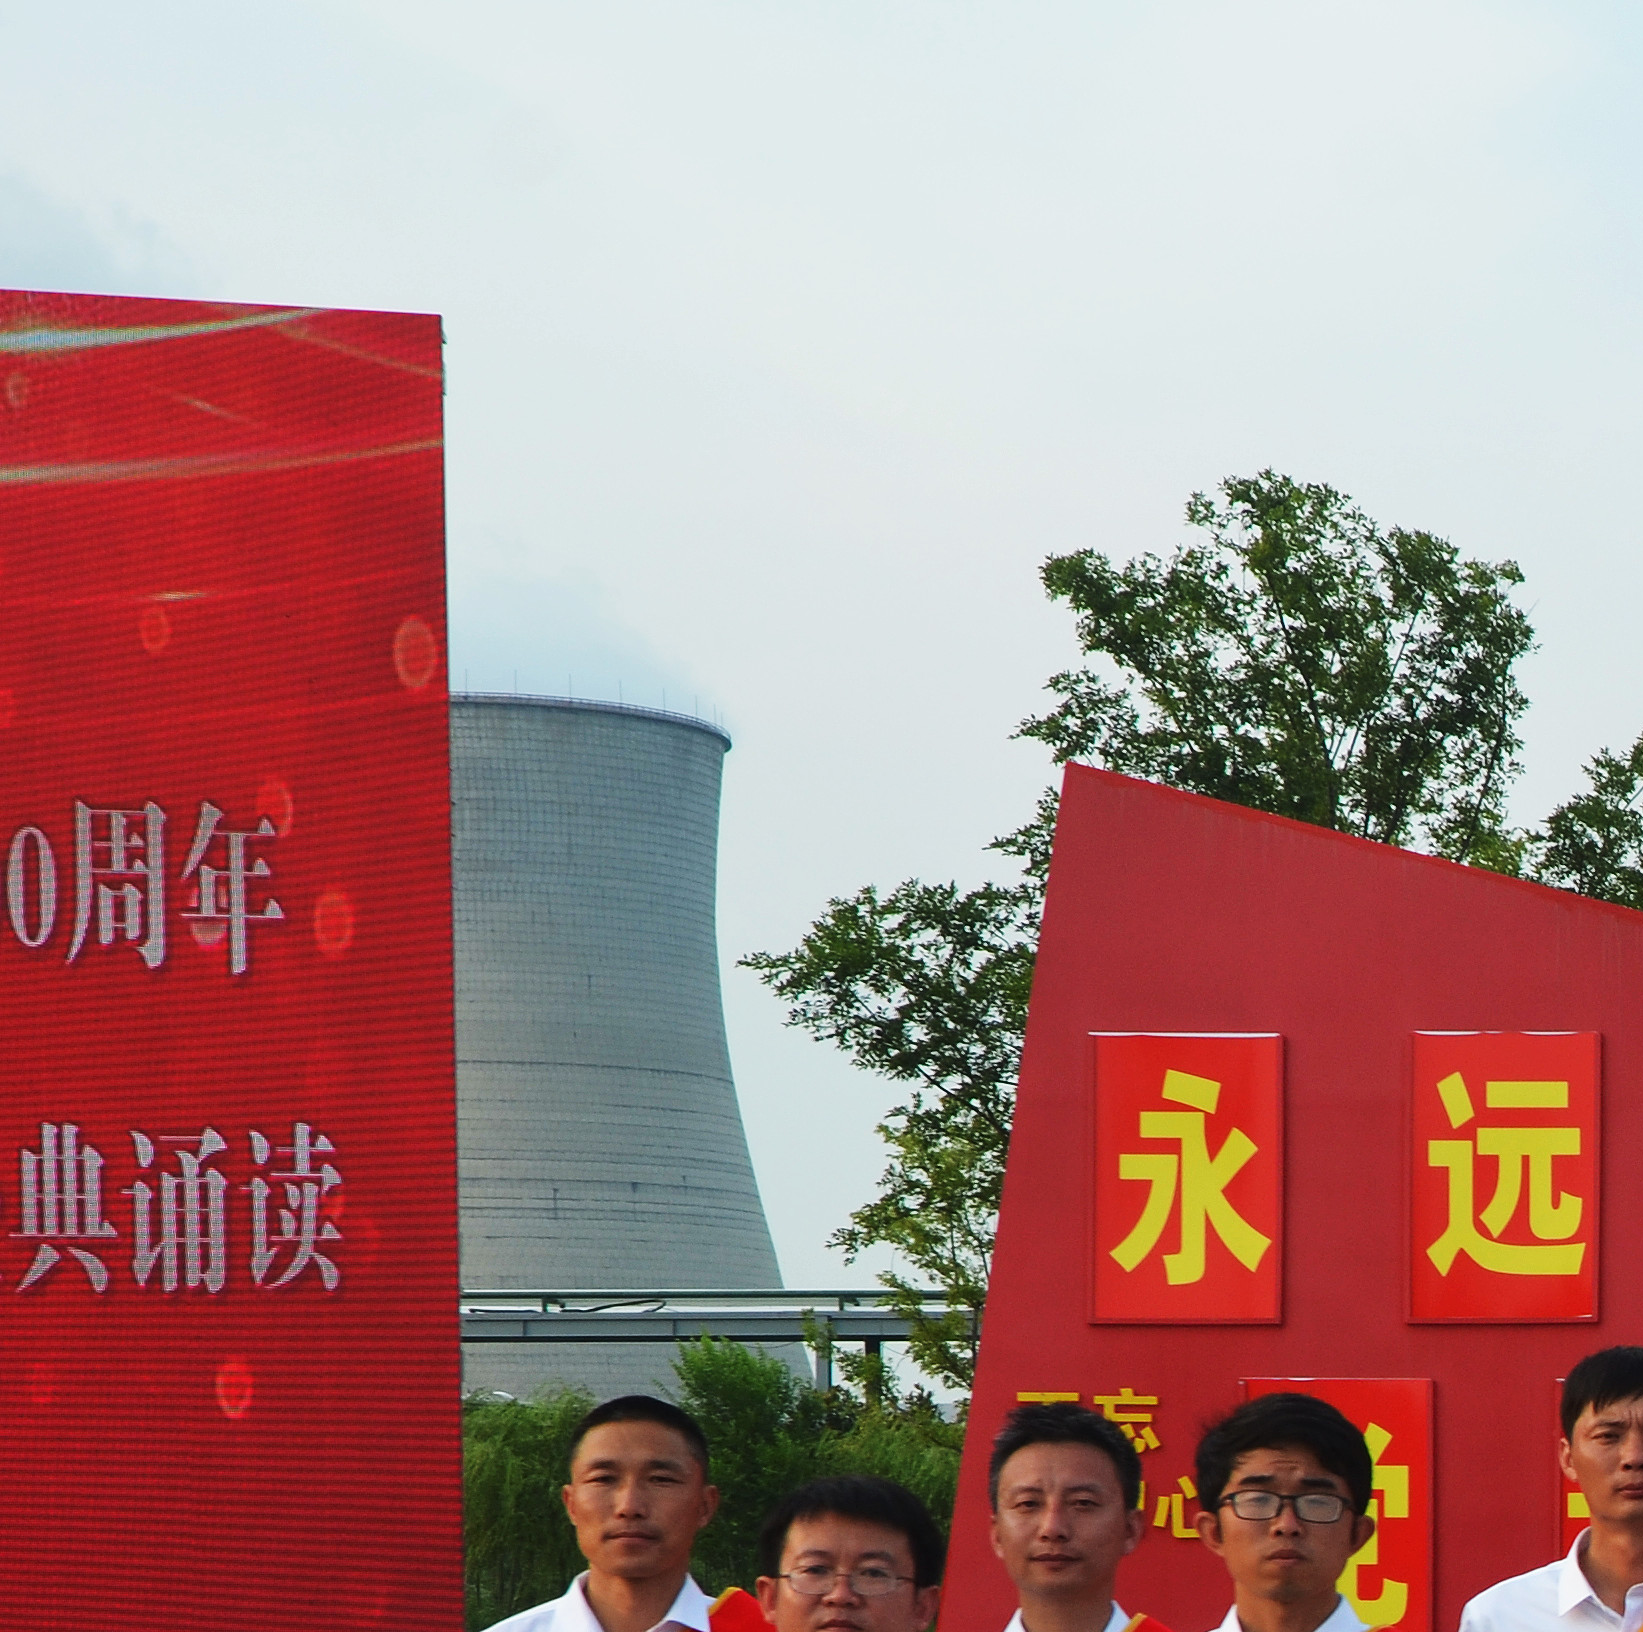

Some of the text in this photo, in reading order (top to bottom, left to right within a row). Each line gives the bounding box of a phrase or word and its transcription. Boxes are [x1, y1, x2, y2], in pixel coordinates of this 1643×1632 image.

[7, 801, 284, 974] 0周年
[9, 1122, 342, 1293] 典诵读
